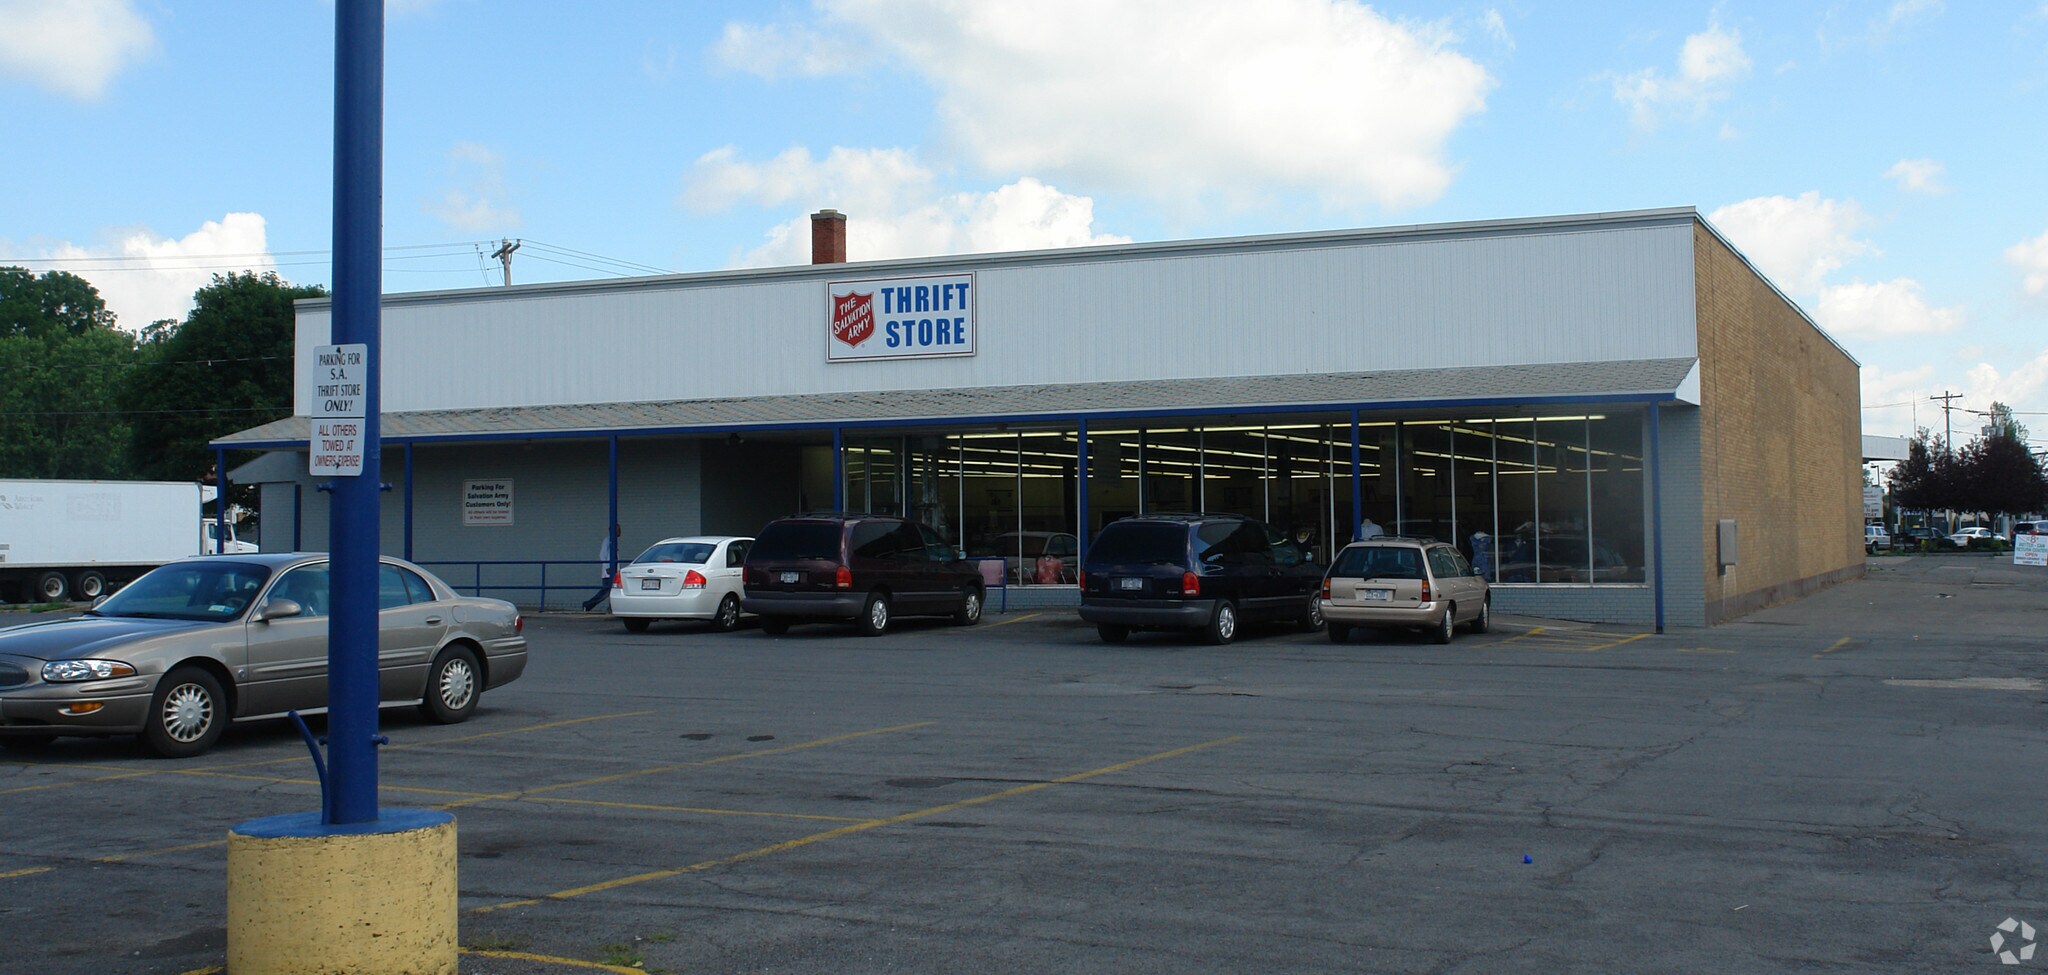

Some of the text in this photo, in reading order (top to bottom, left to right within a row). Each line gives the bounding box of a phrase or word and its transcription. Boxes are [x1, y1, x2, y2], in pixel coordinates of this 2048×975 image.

[881, 283, 970, 314] THRIFT
[839, 297, 857, 316] THE
[834, 299, 871, 335] SALVATION
[847, 315, 871, 341] ARMY
[885, 317, 966, 348] STORE
[319, 352, 361, 366] PARKING FOR
[330, 368, 347, 380] S.A.
[317, 384, 361, 397] THRIFT STORE
[324, 399, 353, 412] ONLY!
[318, 424, 357, 436] ALL OTHERS
[322, 439, 354, 451] TOWED AT
[338, 455, 360, 467] EXPENSE
